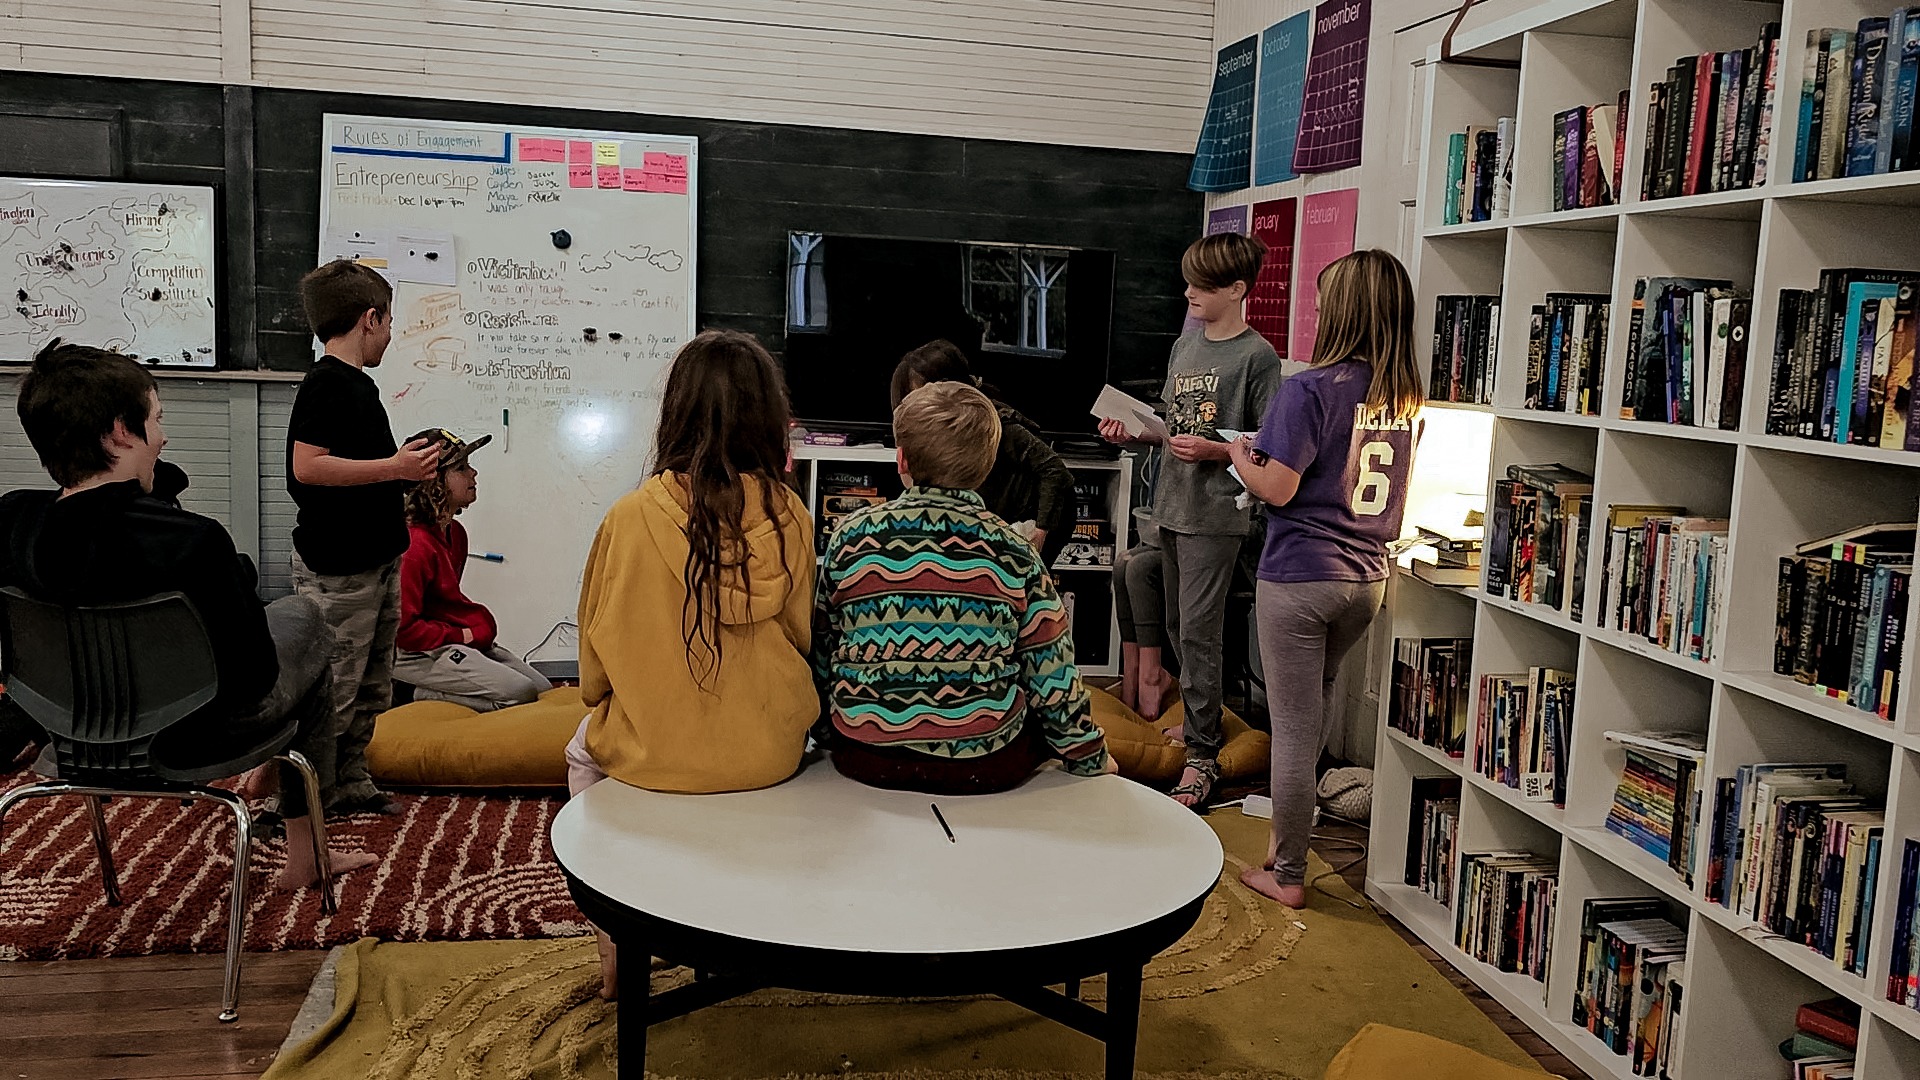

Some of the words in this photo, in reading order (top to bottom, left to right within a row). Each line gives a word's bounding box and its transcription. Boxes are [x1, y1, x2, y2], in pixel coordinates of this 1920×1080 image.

[1317, 1, 1361, 35] november
[1264, 31, 1293, 57] october
[1219, 50, 1254, 77] september
[1862, 39, 1884, 103] Dragon
[343, 125, 389, 145] Rules
[417, 130, 483, 152] Engagement
[334, 162, 479, 196] Entrepreneurship
[1209, 218, 1241, 233] december
[1254, 211, 1280, 234] january
[1306, 204, 1340, 227] february
[137, 264, 204, 284] Competition
[138, 287, 198, 301] Sustitute
[1877, 345, 1885, 367] PAX
[1351, 441, 1395, 516] 6
